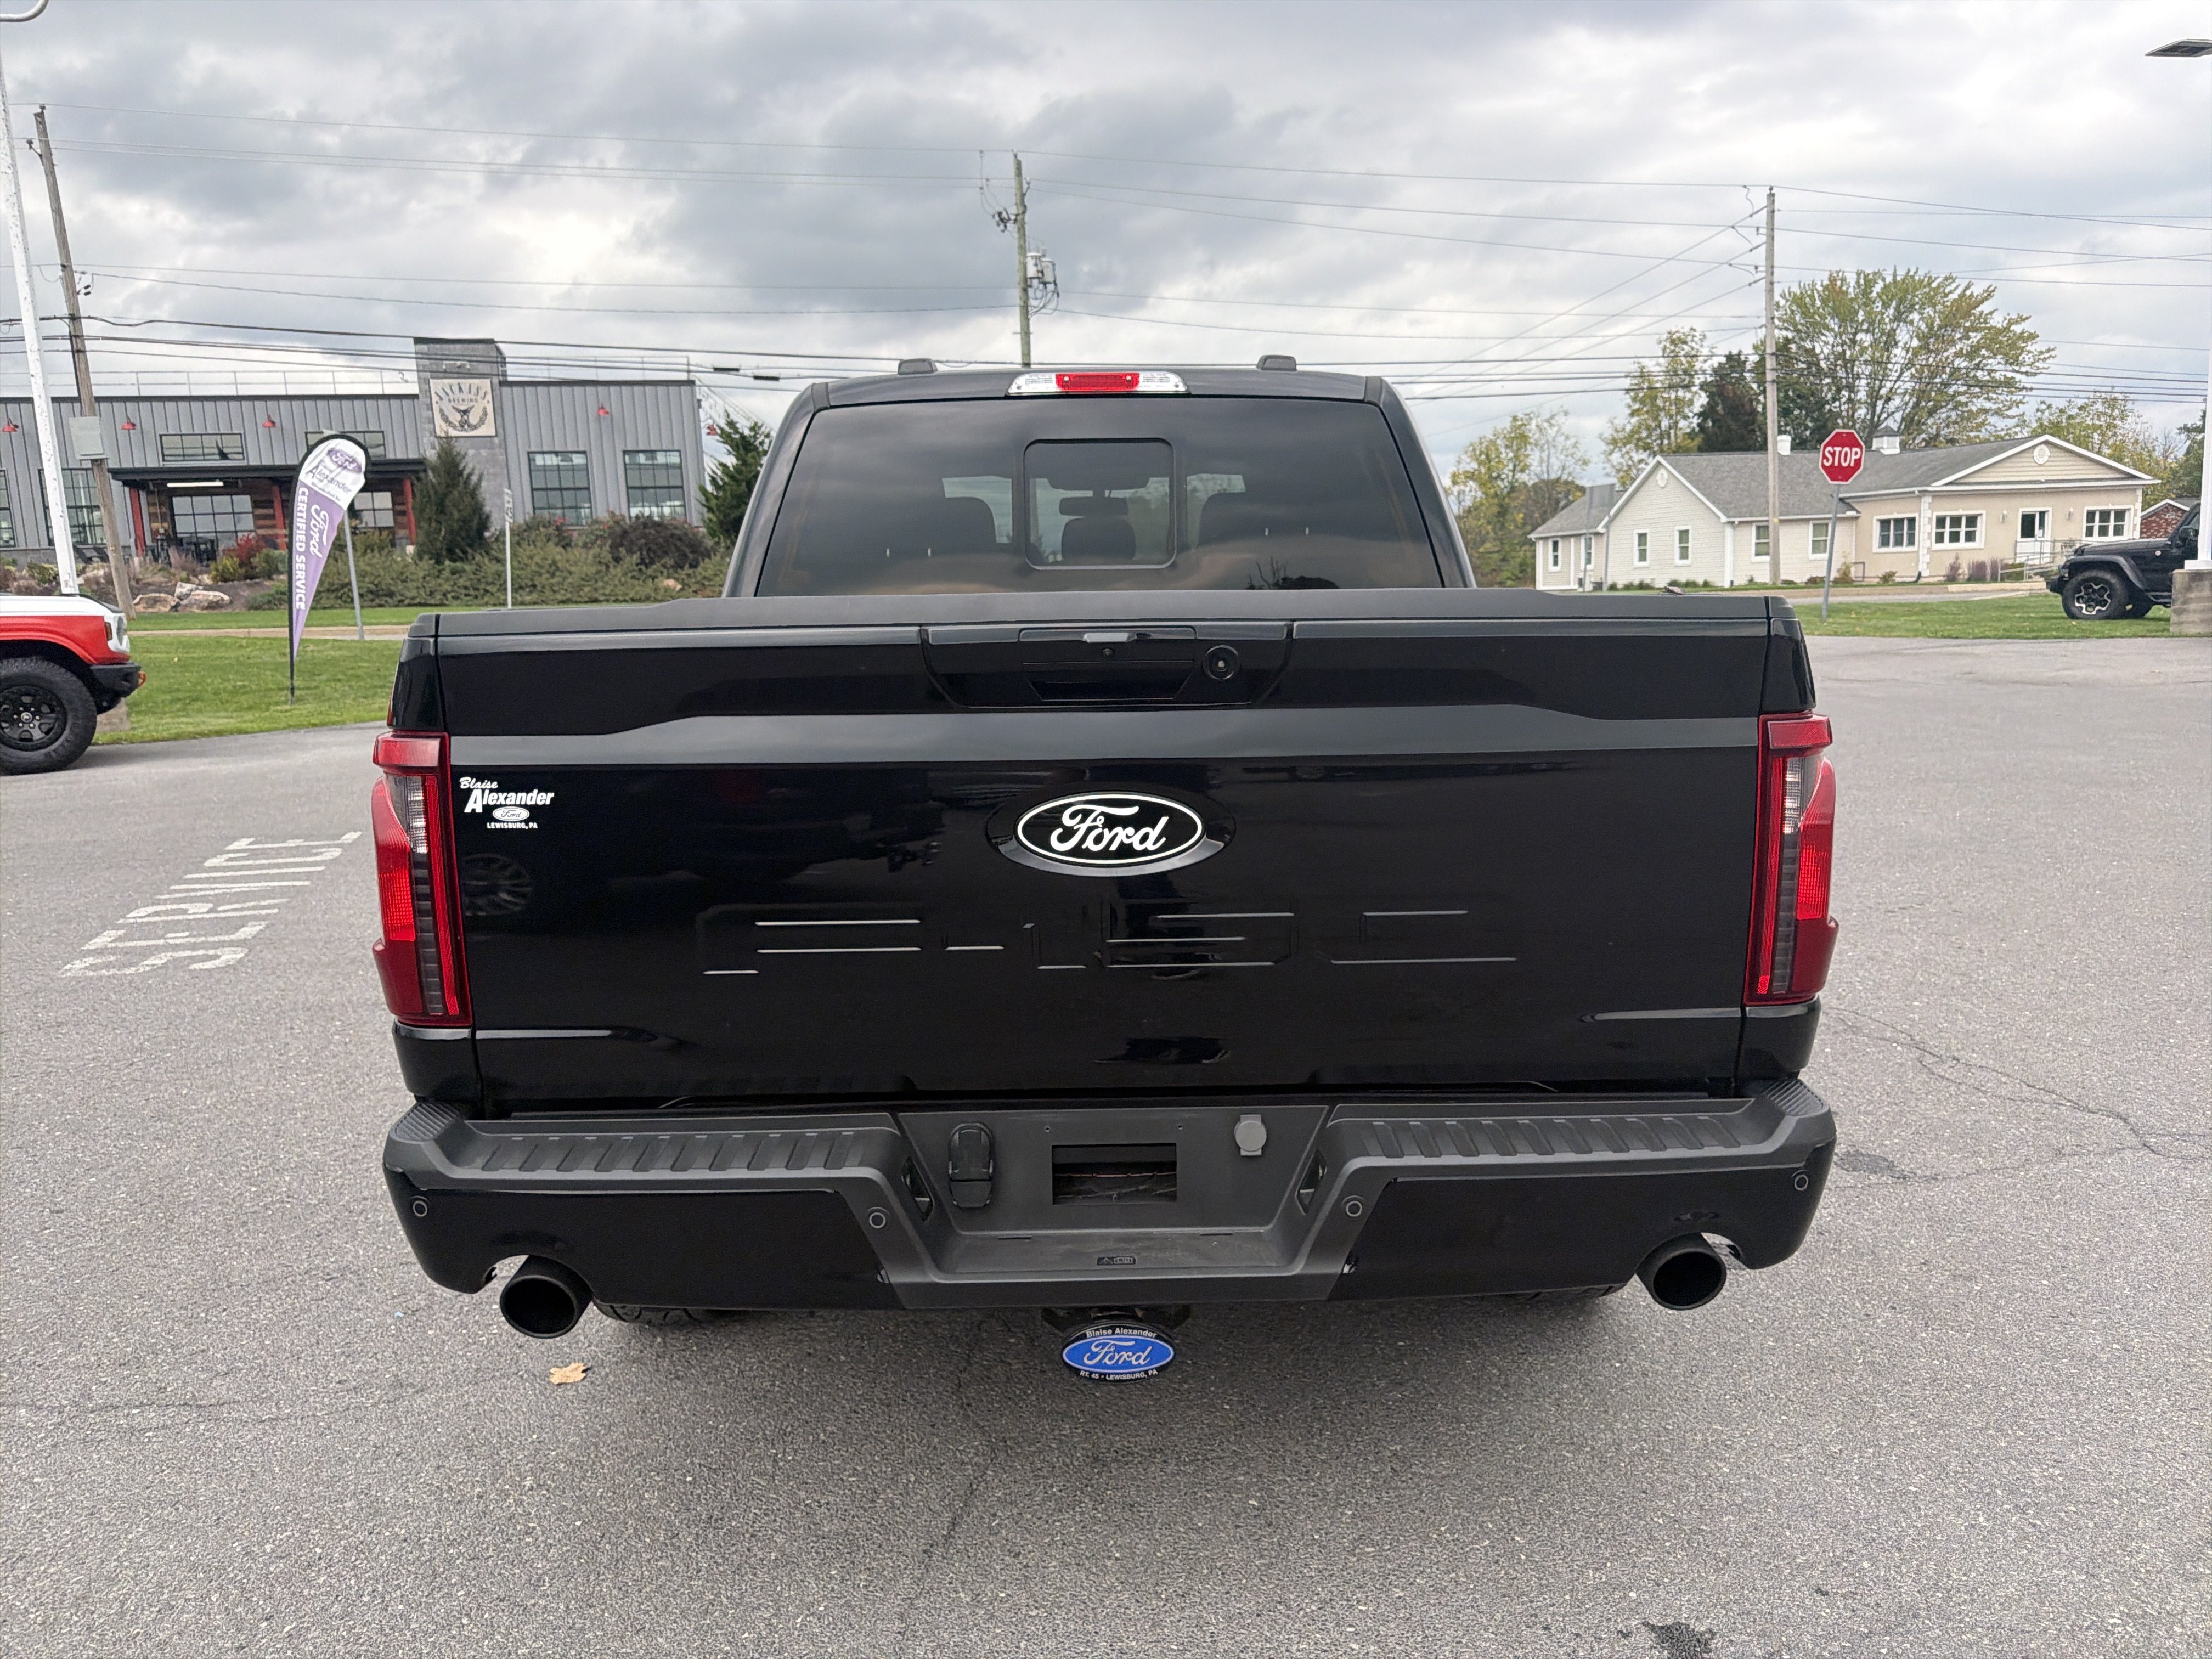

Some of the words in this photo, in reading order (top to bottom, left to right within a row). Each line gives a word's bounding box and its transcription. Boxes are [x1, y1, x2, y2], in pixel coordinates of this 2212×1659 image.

[1823, 446, 1861, 467] STOP
[296, 487, 308, 552] CERTIFIED
[309, 504, 329, 558] Ford
[295, 555, 306, 610] SERVICE
[459, 776, 499, 789] Blaise
[464, 789, 555, 814] Alexander
[500, 809, 522, 819] Ford
[1049, 804, 1169, 852] Ford
[1086, 1328, 1112, 1338] Blaise
[1115, 1327, 1158, 1338] Alexander
[1083, 1339, 1153, 1365] Ford
[1105, 1371, 1148, 1380] LEWISBURG,
